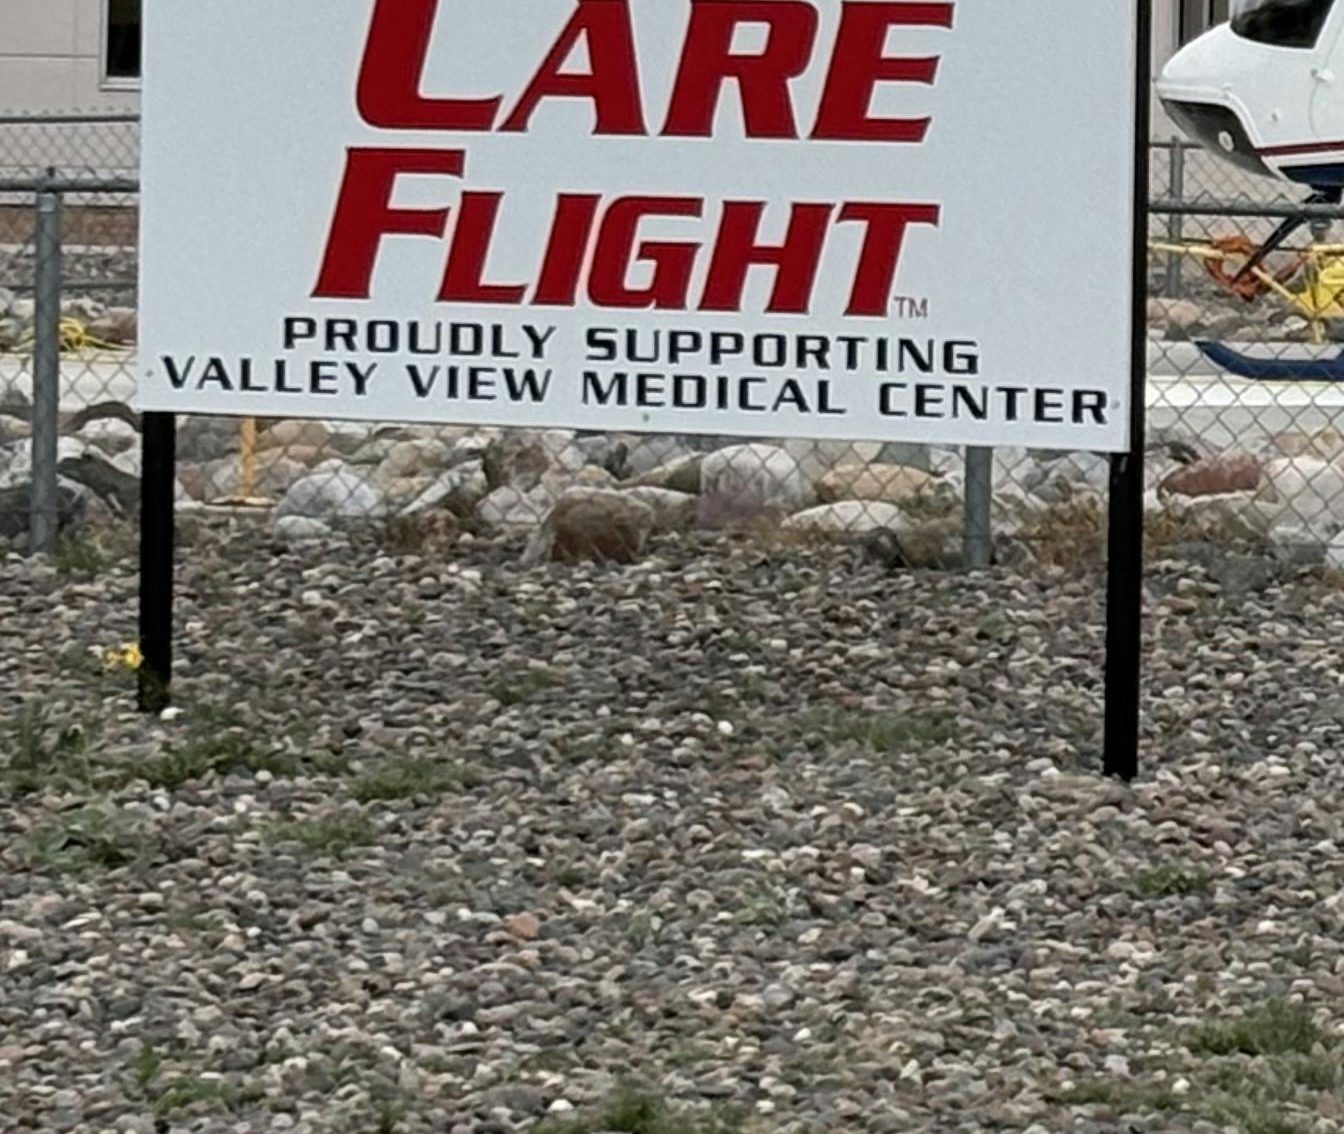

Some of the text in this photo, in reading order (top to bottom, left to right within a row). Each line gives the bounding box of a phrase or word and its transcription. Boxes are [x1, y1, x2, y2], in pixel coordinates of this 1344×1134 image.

[309, 146, 940, 317] FLIGHT
[283, 317, 979, 375] PROUDLY SUPPORTING
[161, 355, 1108, 425] VALLEY VIEW MEDICAL CENTER
